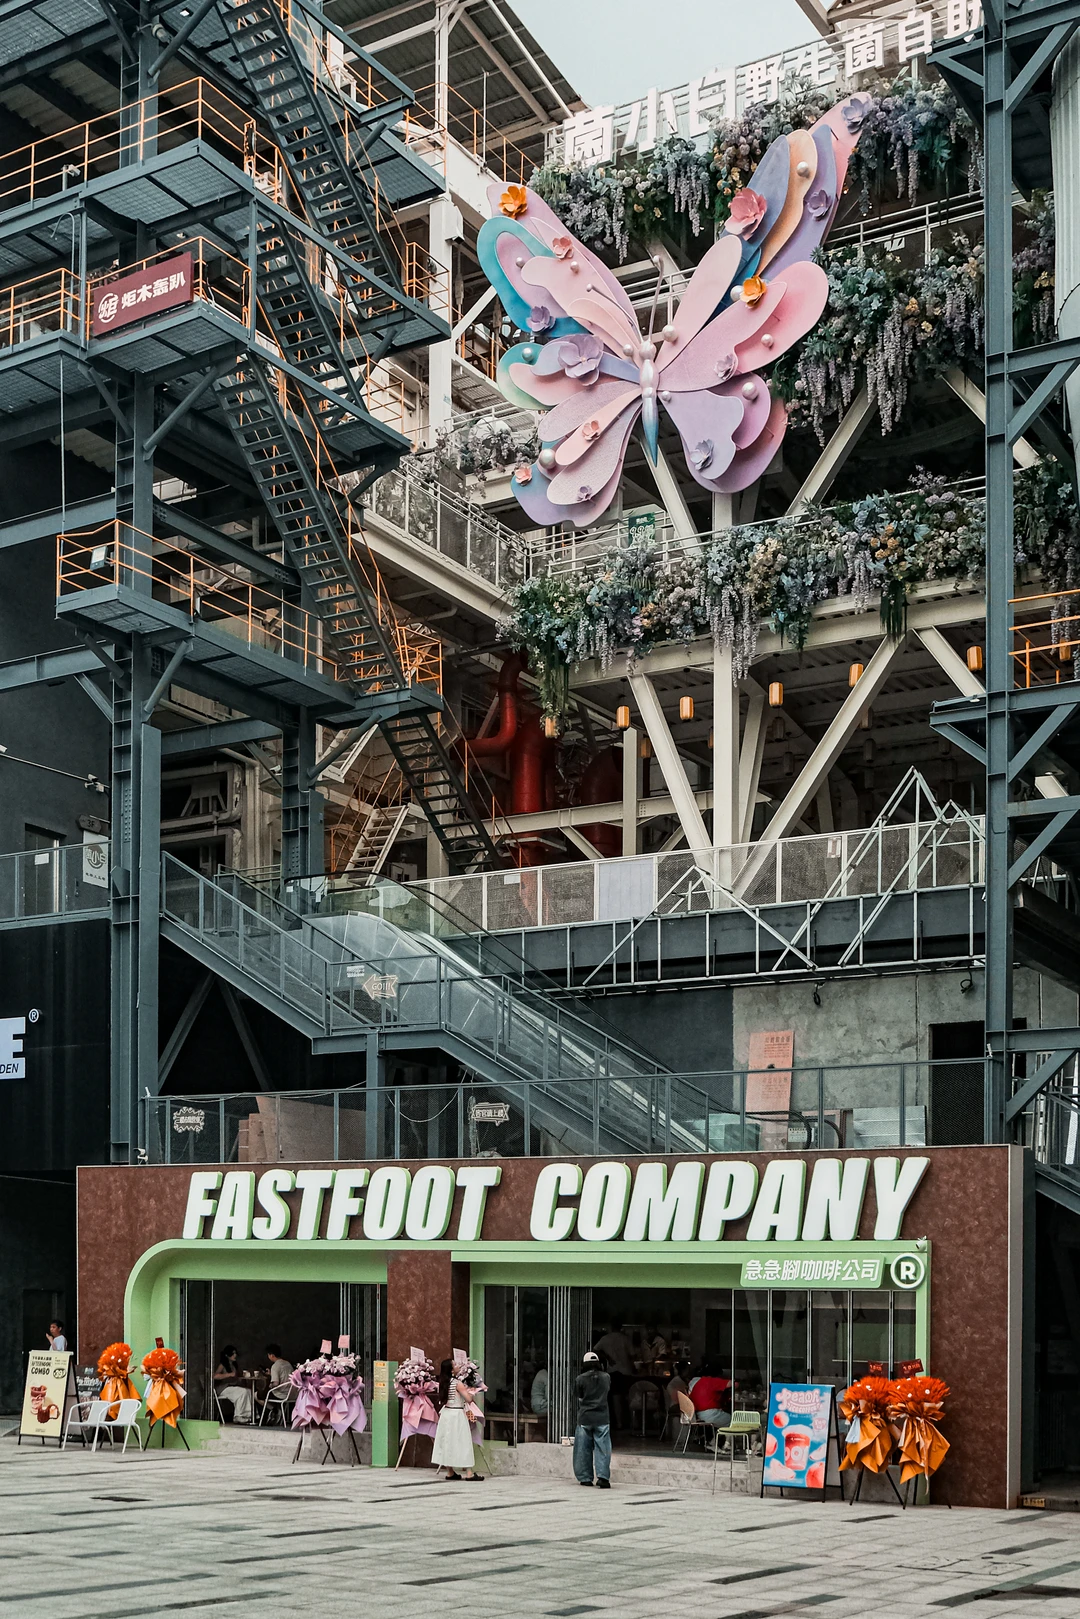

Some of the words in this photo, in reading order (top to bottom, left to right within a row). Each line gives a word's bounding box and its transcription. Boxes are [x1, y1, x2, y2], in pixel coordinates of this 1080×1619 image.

[182, 1164, 502, 1241] FASTFOOT
[529, 1156, 931, 1242] COMPANY
[744, 1259, 881, 1282] 急急腳咖啡公司
[31, 1367, 50, 1376] COMBO
